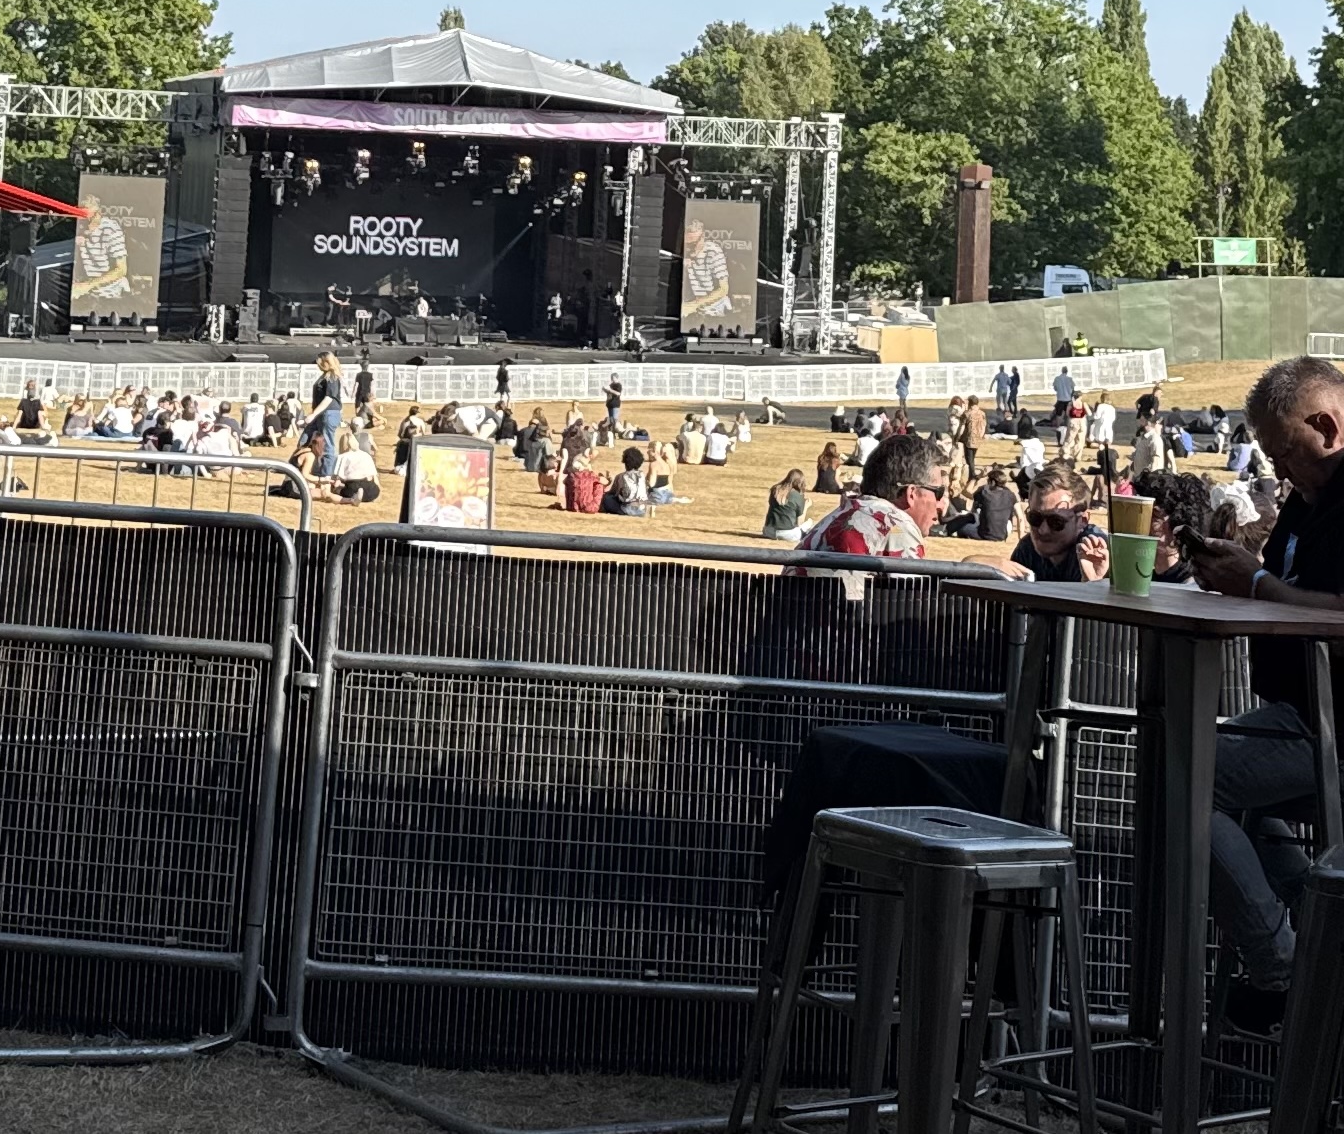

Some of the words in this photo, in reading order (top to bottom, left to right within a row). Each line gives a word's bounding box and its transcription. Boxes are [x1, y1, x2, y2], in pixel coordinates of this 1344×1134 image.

[393, 107, 448, 127] SOUTH
[100, 205, 134, 216] OOTY
[349, 216, 422, 237] ROOTY
[704, 229, 734, 240] OOTY
[313, 234, 459, 258] SOUNDSYSTEM
